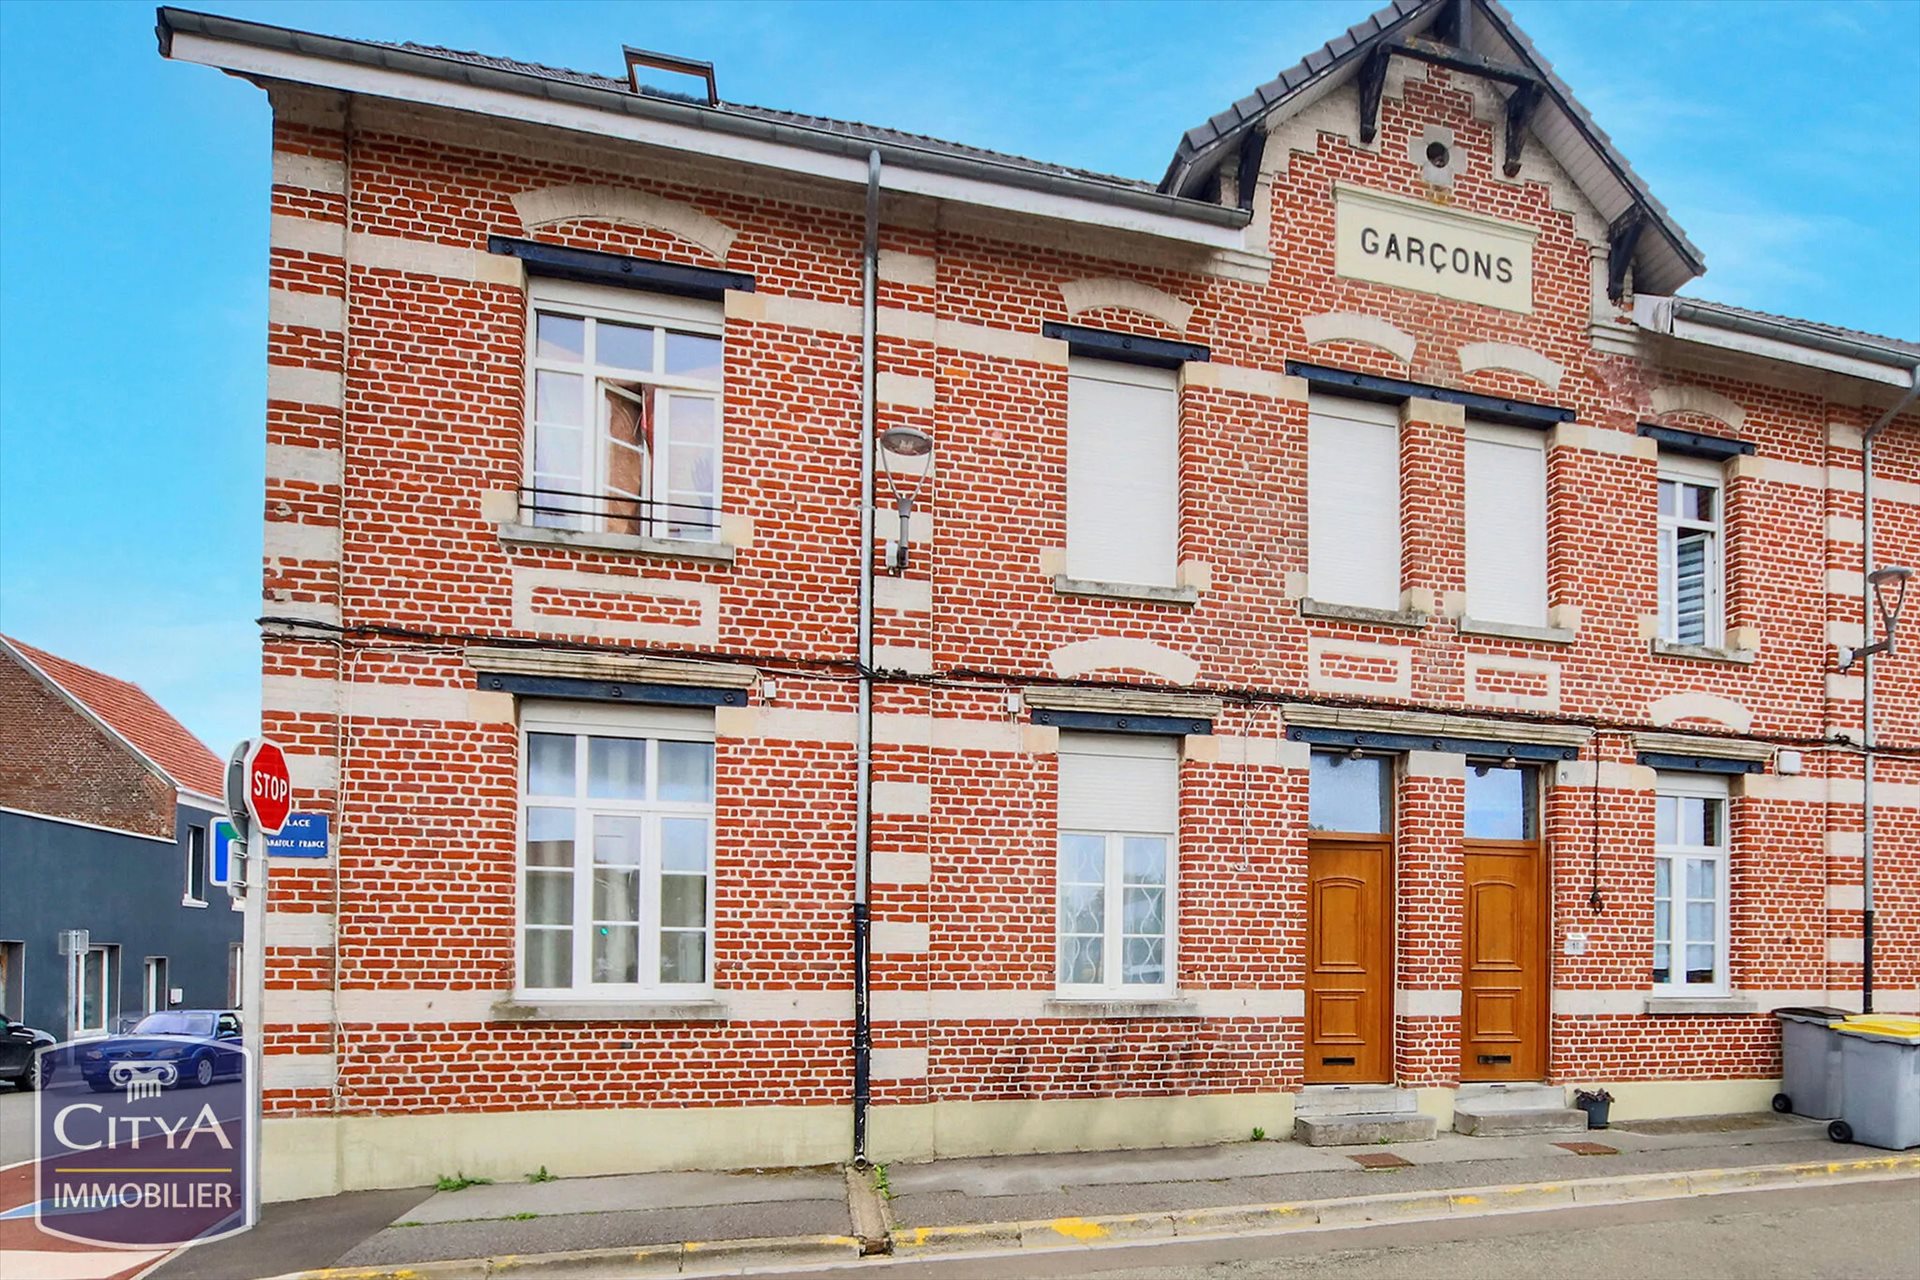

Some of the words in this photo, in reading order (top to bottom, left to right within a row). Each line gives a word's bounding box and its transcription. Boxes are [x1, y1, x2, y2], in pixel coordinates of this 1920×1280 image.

[1360, 227, 1513, 284] GARÇONS
[254, 770, 288, 803] STOP
[286, 819, 311, 828] LACE
[298, 840, 325, 849] FRANCE
